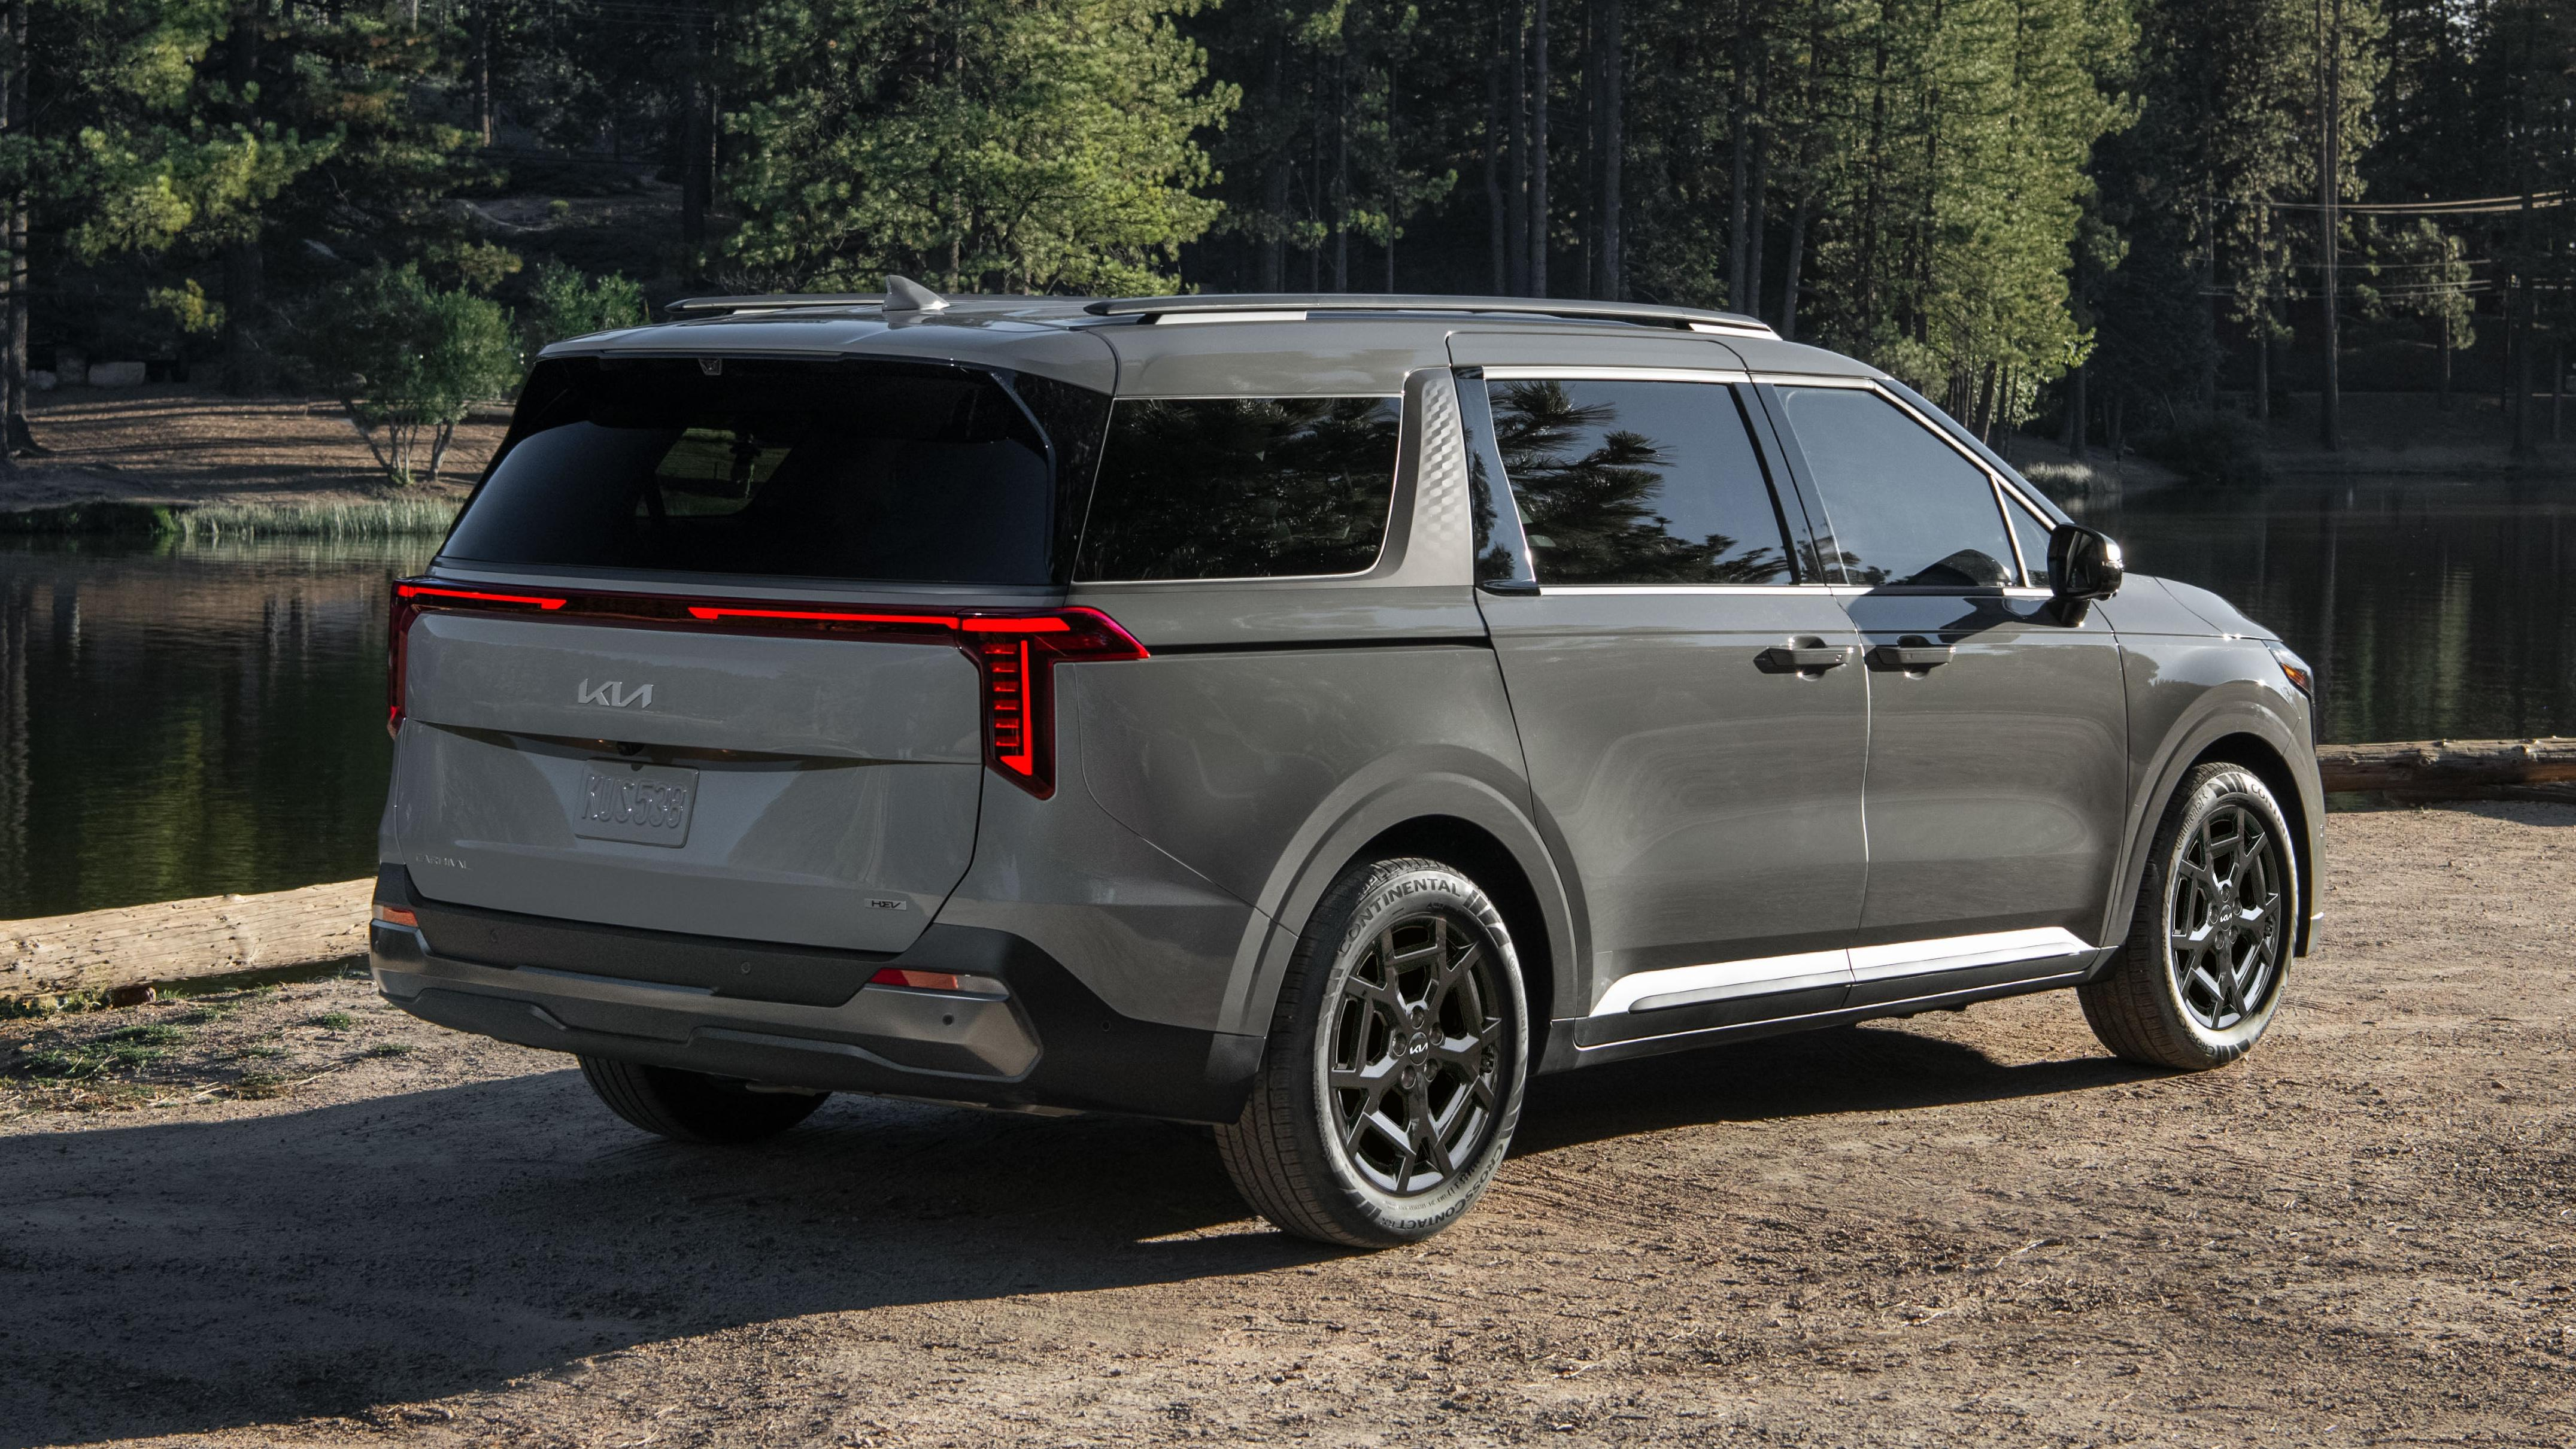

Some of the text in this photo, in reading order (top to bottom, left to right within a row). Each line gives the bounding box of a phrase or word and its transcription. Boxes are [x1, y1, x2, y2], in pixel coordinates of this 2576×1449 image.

[578, 679, 653, 709] KIA
[872, 900, 901, 909] HEV
[1339, 879, 1461, 953] CONTINENTAL
[2220, 912, 2232, 923] KIA
[1409, 1042, 1428, 1055] KIA
